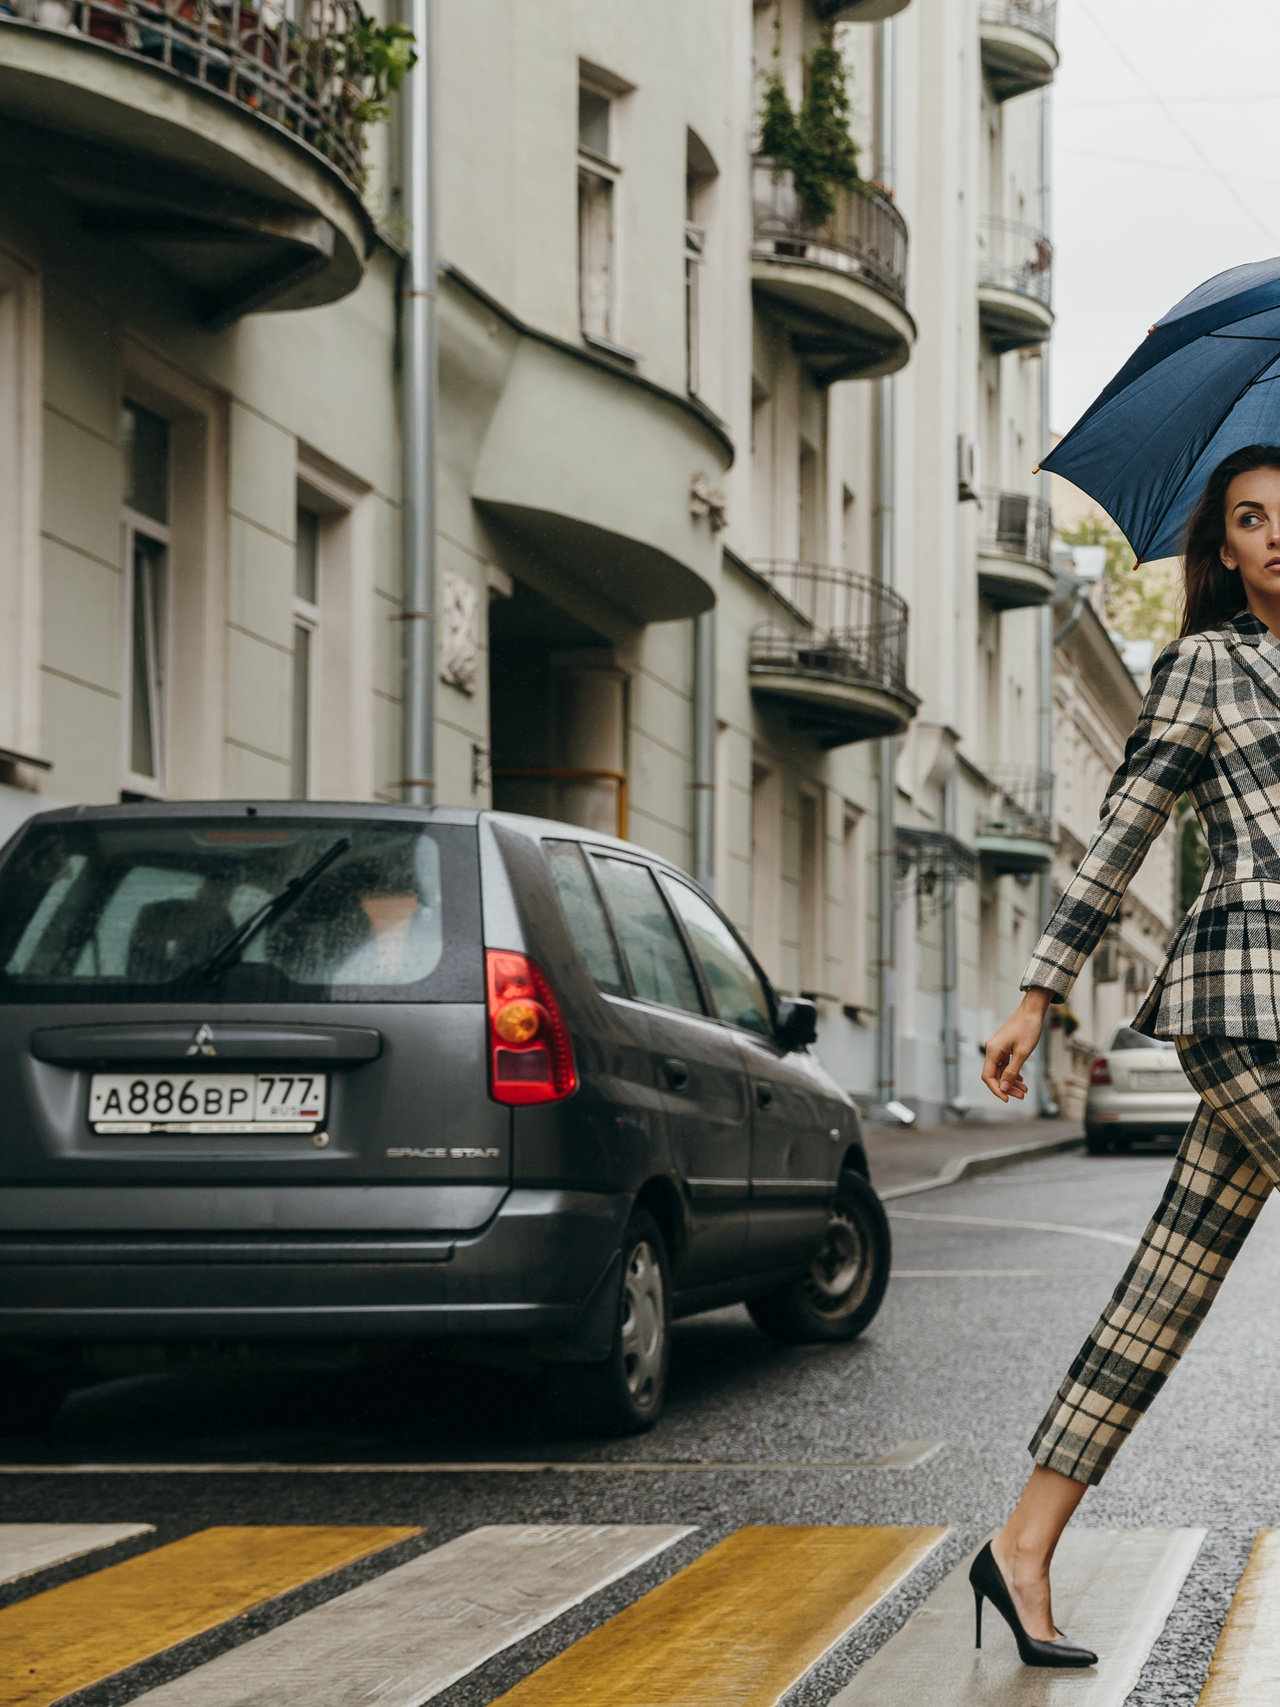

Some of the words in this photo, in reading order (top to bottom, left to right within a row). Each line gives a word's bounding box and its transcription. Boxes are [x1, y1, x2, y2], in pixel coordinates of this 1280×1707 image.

[259, 1078, 314, 1104] 777
[386, 1147, 447, 1158] SPACE
[450, 1147, 500, 1158] STAR
